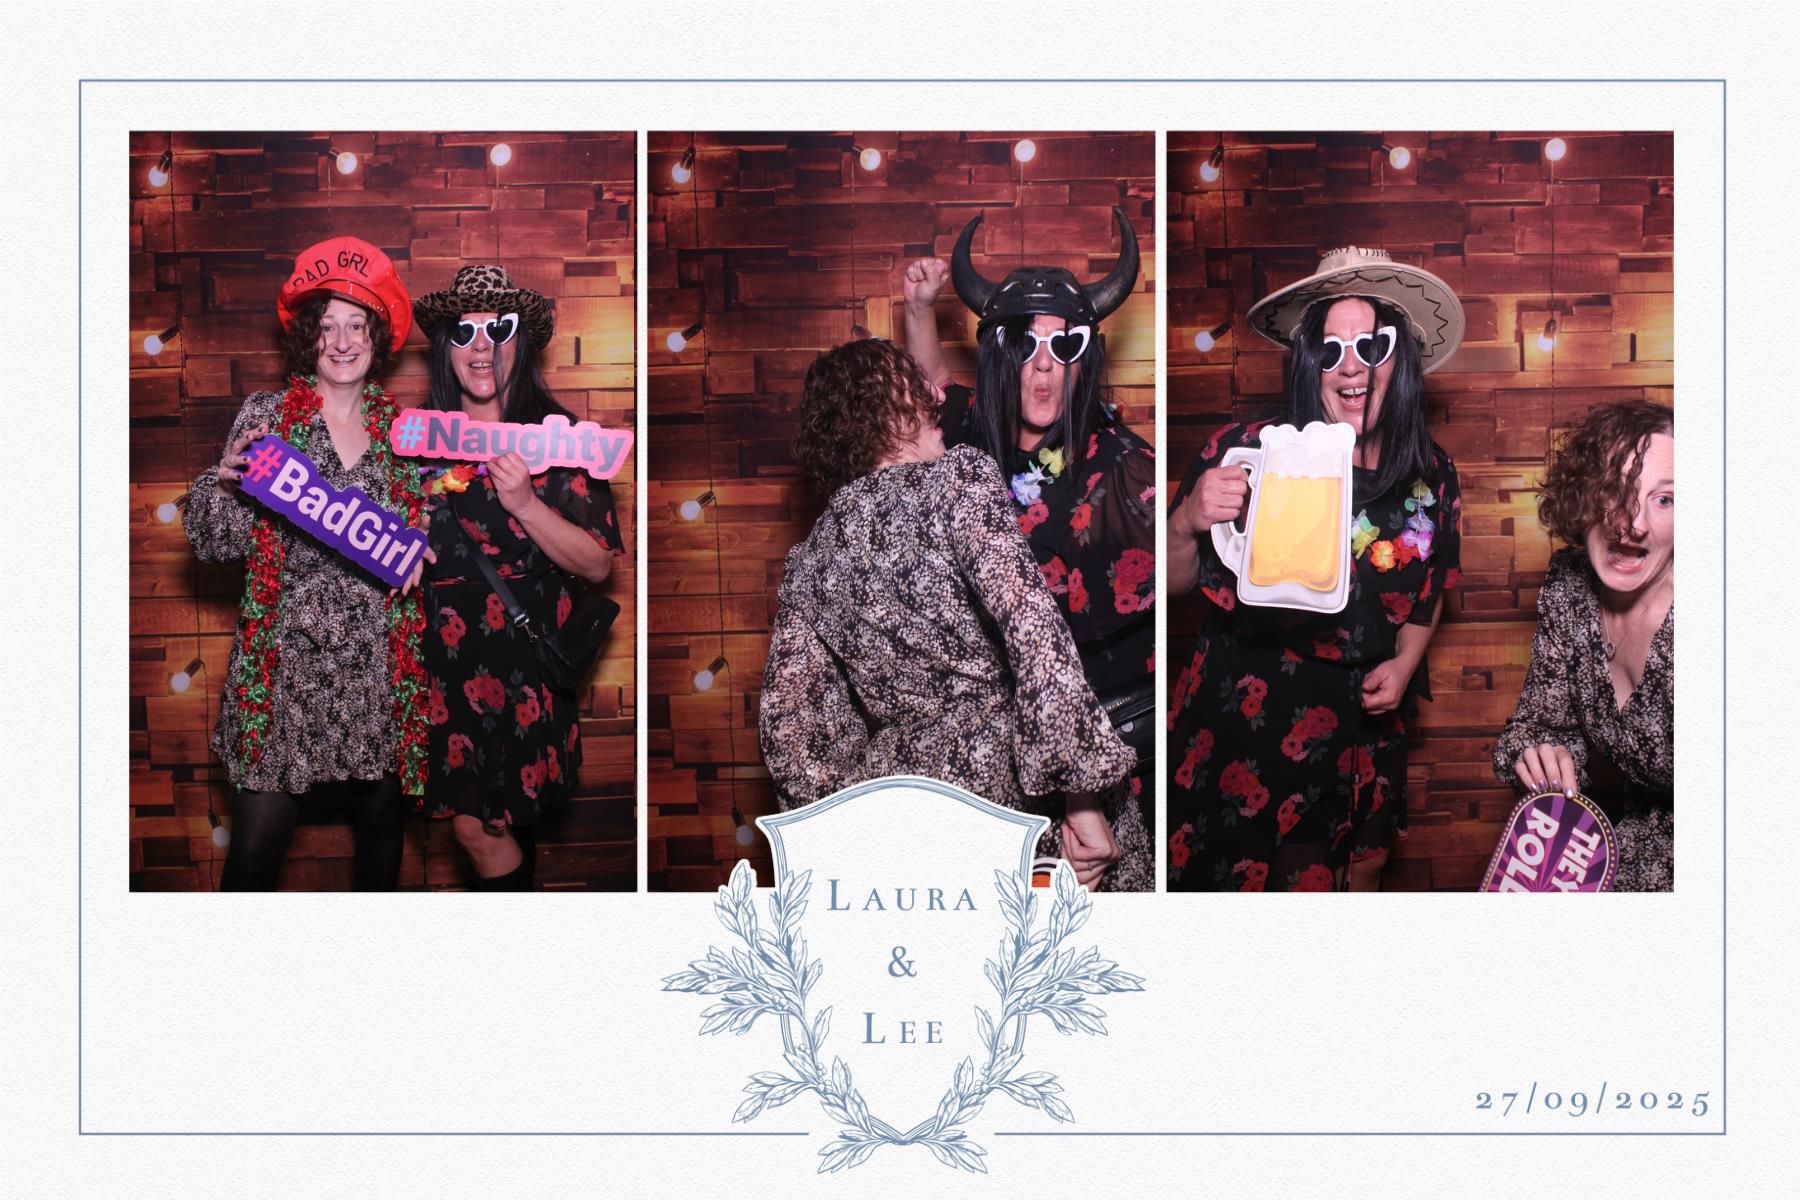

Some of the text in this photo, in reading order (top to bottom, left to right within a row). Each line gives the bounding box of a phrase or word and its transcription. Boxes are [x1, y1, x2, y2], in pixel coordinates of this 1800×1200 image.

[396, 416, 625, 473] #Naughty
[245, 444, 423, 577] #BadGirl
[1551, 826, 1601, 892] THEY
